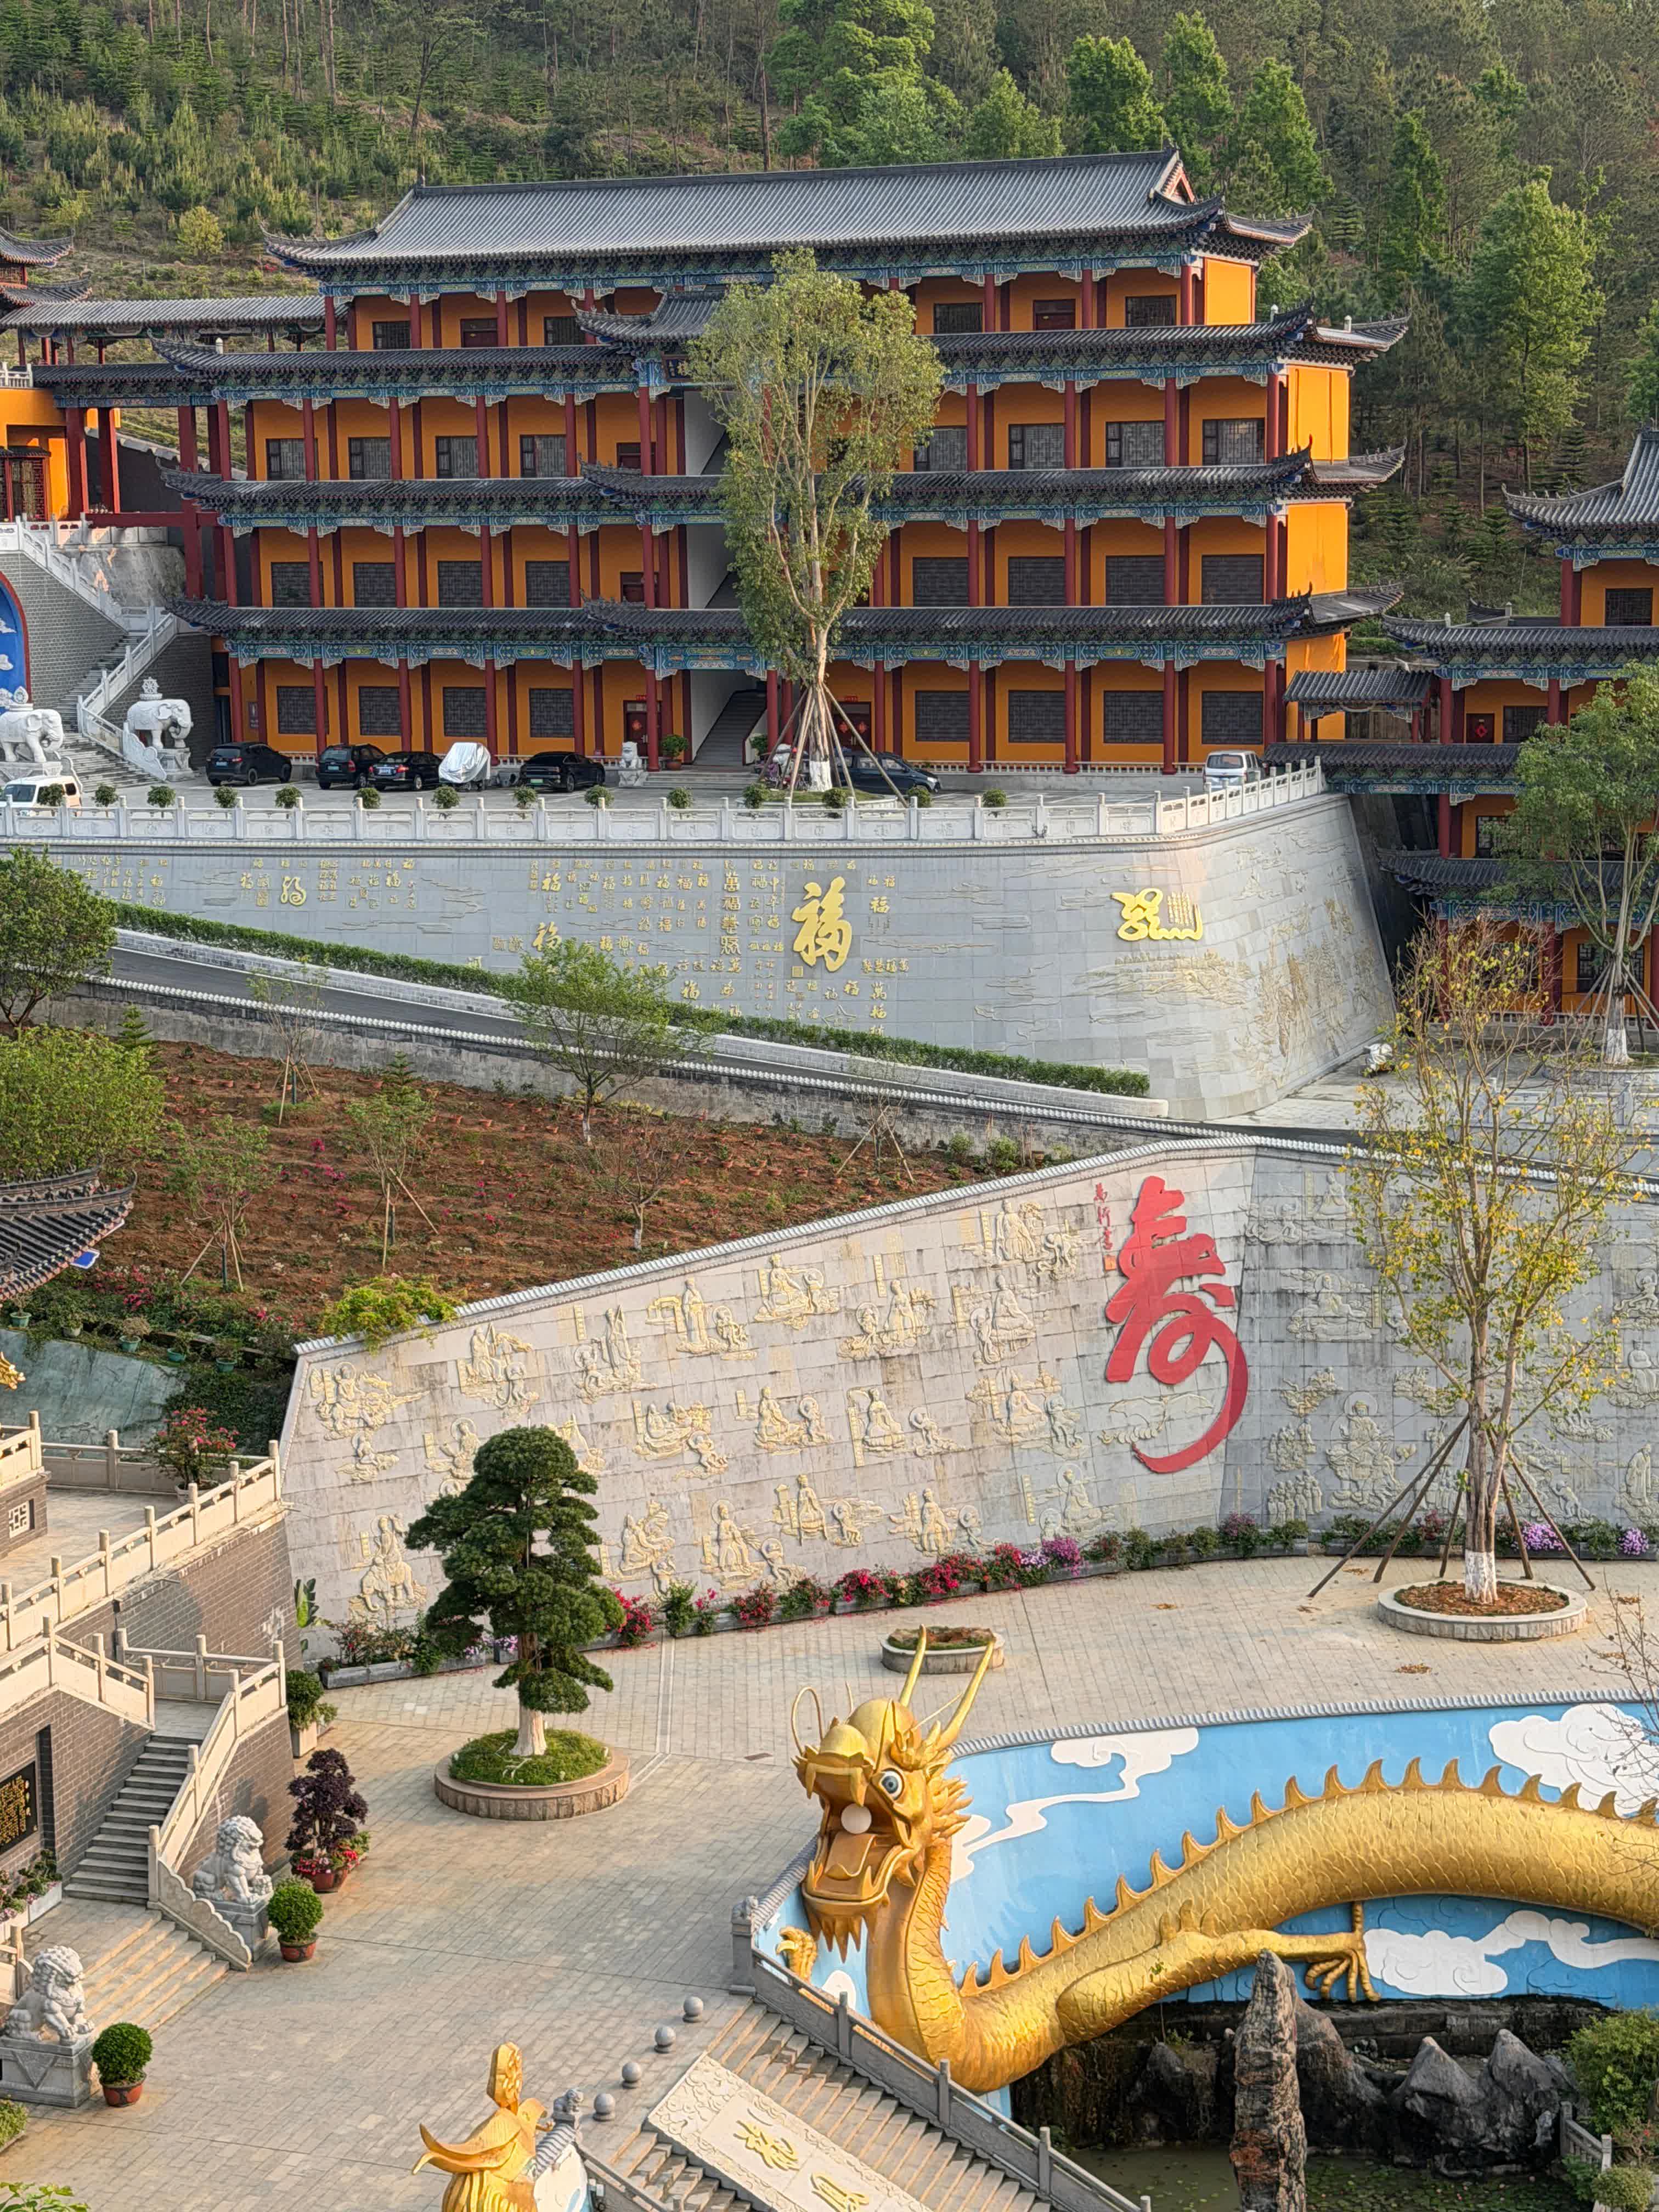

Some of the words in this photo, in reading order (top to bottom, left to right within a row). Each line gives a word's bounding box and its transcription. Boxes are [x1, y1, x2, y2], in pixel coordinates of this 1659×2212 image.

[541, 872, 561, 891] 福
[677, 875, 692, 890] 福
[870, 896, 890, 913] 福
[792, 876, 852, 972] 福
[681, 980, 700, 1000] 福
[844, 980, 860, 996] 福
